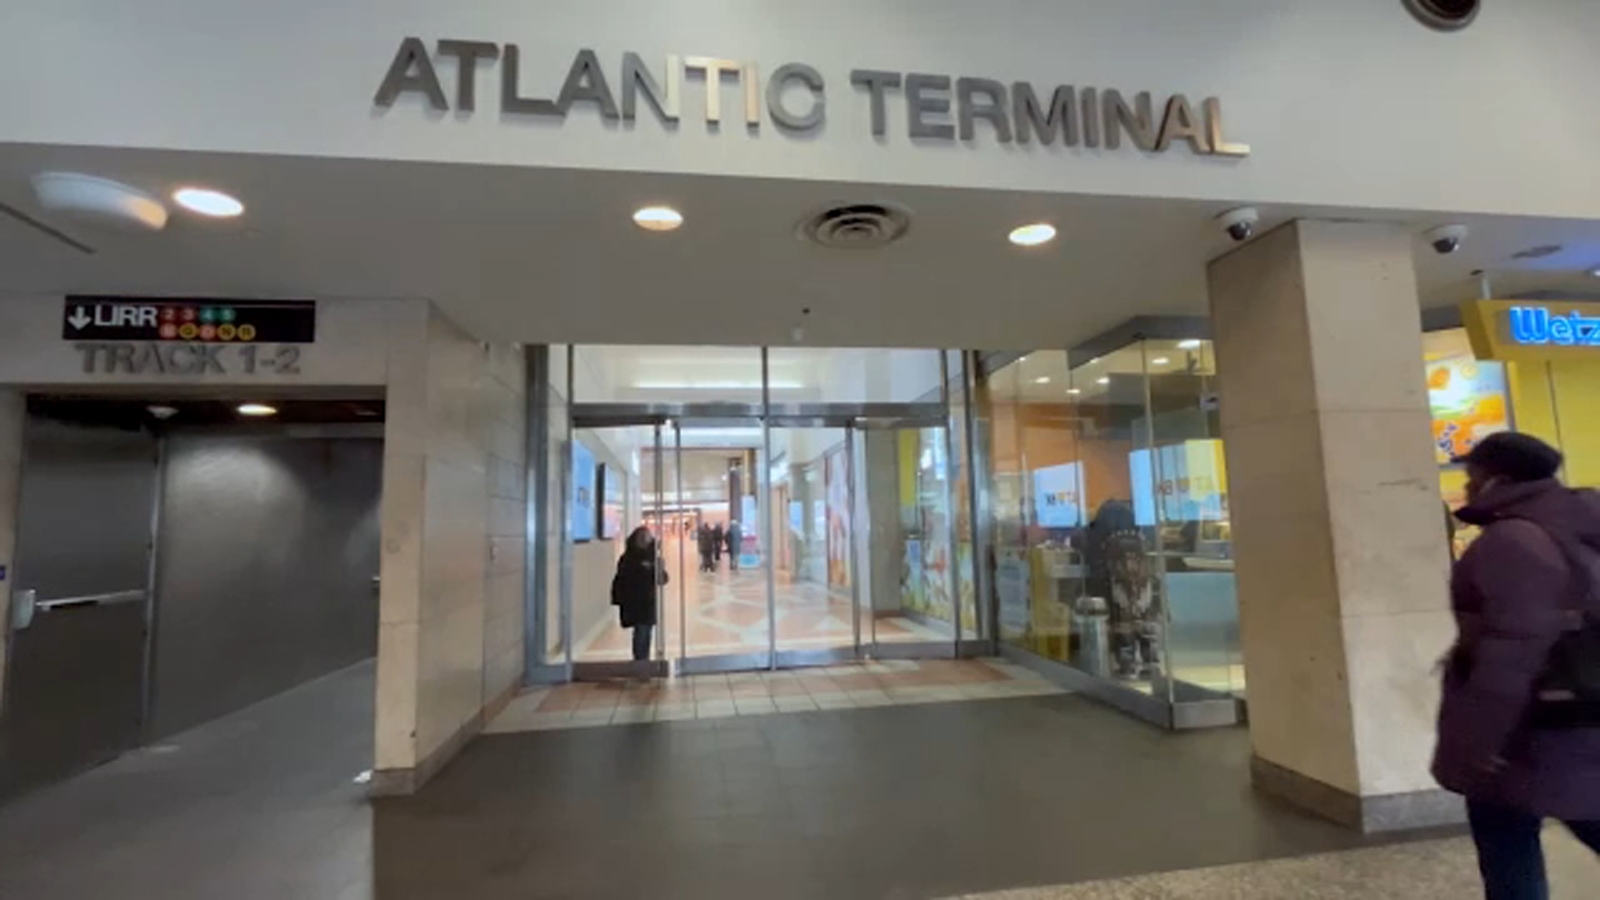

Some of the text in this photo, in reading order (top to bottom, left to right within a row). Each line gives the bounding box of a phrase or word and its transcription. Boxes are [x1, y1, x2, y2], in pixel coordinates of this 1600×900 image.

[373, 36, 1250, 157] ATLANTIC TERMINAL
[94, 304, 157, 327] LIRR
[75, 342, 300, 374] TRACK 1-2
